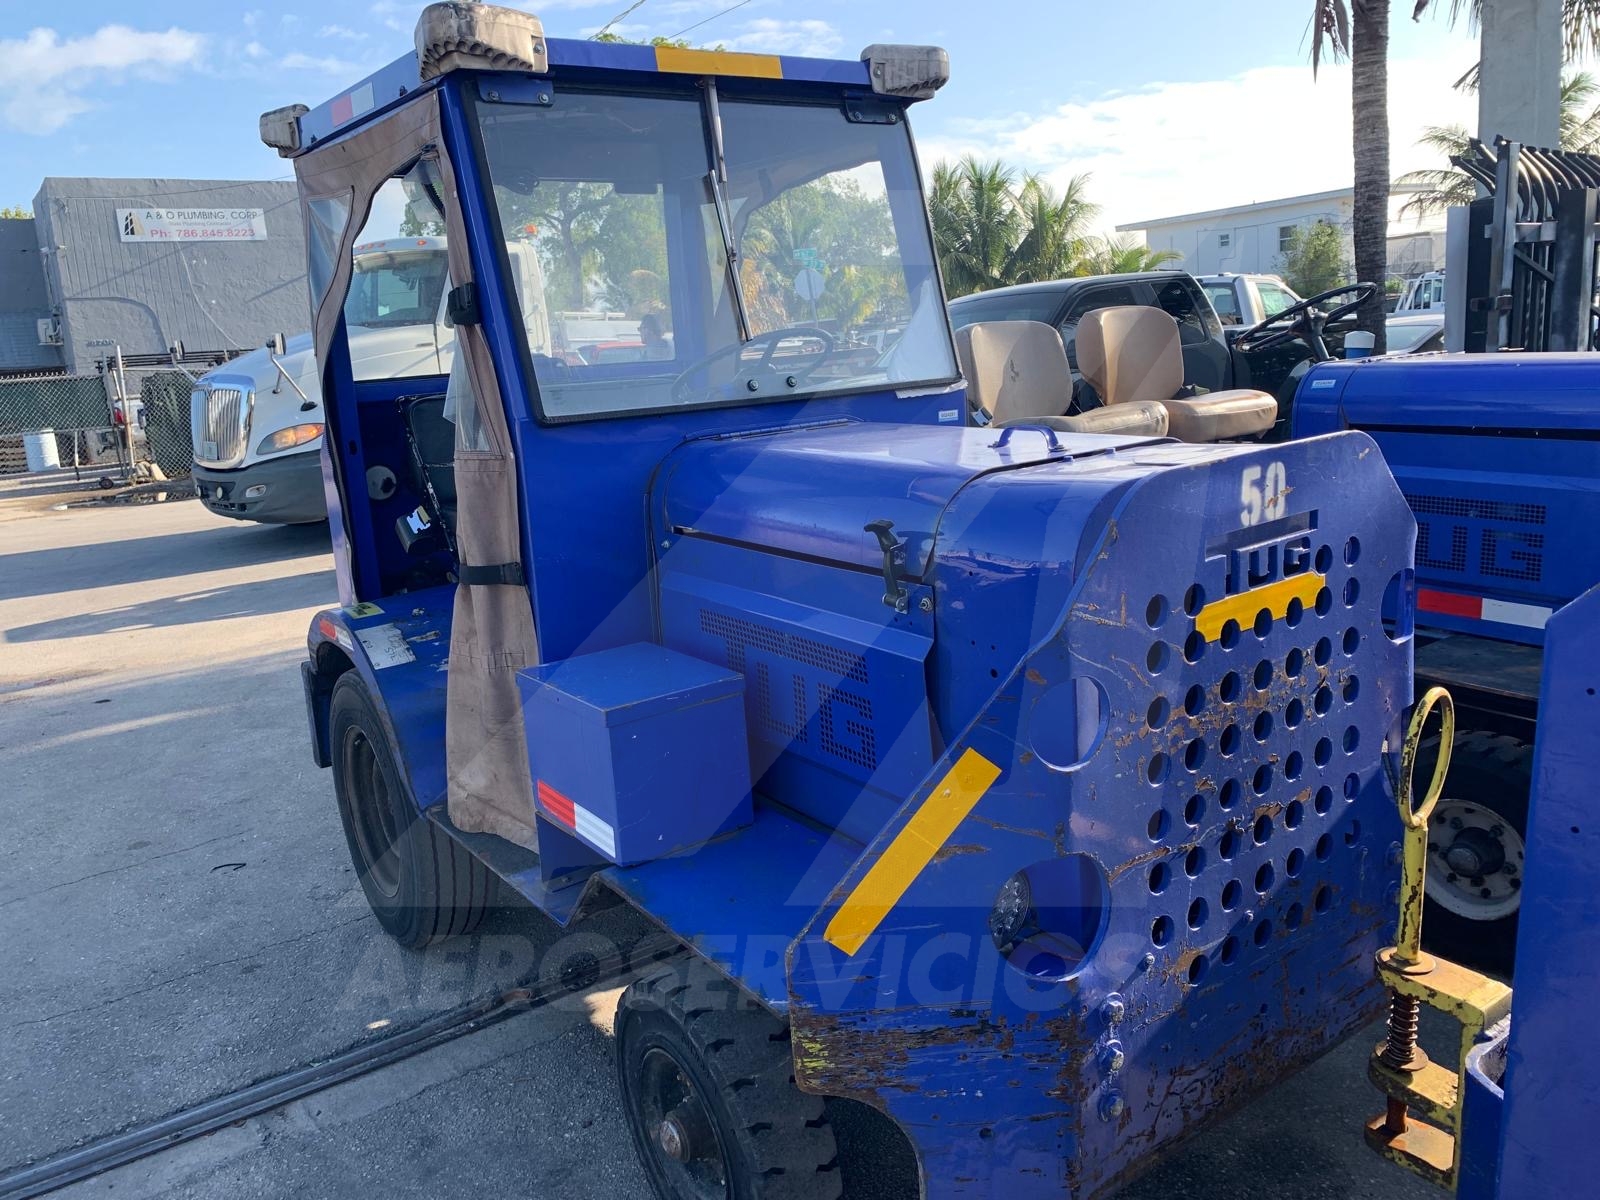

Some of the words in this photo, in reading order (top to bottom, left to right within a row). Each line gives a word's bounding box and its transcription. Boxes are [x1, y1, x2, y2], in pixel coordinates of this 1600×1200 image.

[145, 211, 154, 220] A
[155, 211, 163, 220] &
[151, 229, 171, 238] Ph:
[1240, 461, 1287, 527] 50
[1205, 509, 1319, 597] TUG
[699, 608, 877, 770] TUG
